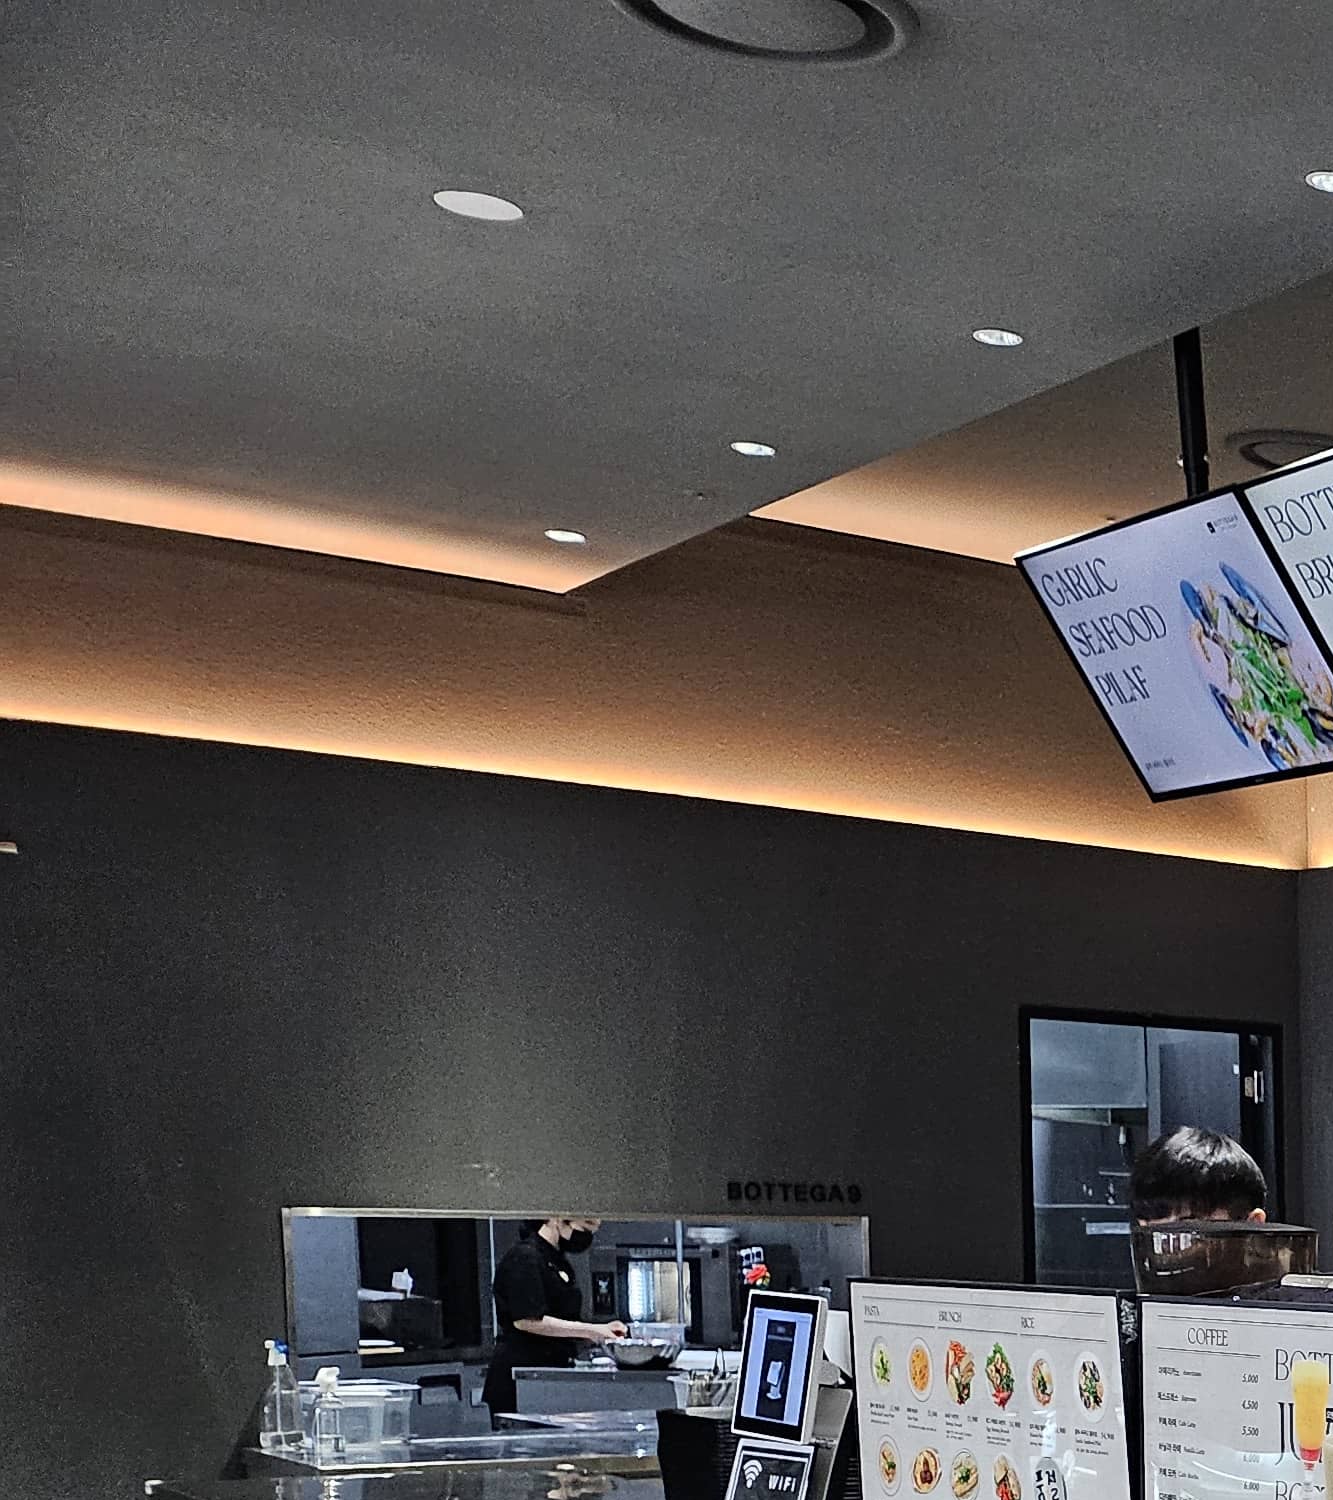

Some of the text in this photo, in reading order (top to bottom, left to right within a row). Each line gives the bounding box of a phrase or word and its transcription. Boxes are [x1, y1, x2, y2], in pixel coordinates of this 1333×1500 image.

[1041, 557, 1118, 607] GARLIC
[1068, 604, 1167, 658] SEAFOOD
[1094, 664, 1151, 707] PILAF
[1187, 1327, 1229, 1347] COFFEE
[1241, 1373, 1259, 1384] 5,000
[1241, 1399, 1259, 1411] 4,500
[1241, 1425, 1259, 1437] 5,500
[768, 1474, 797, 1493] WIFI
